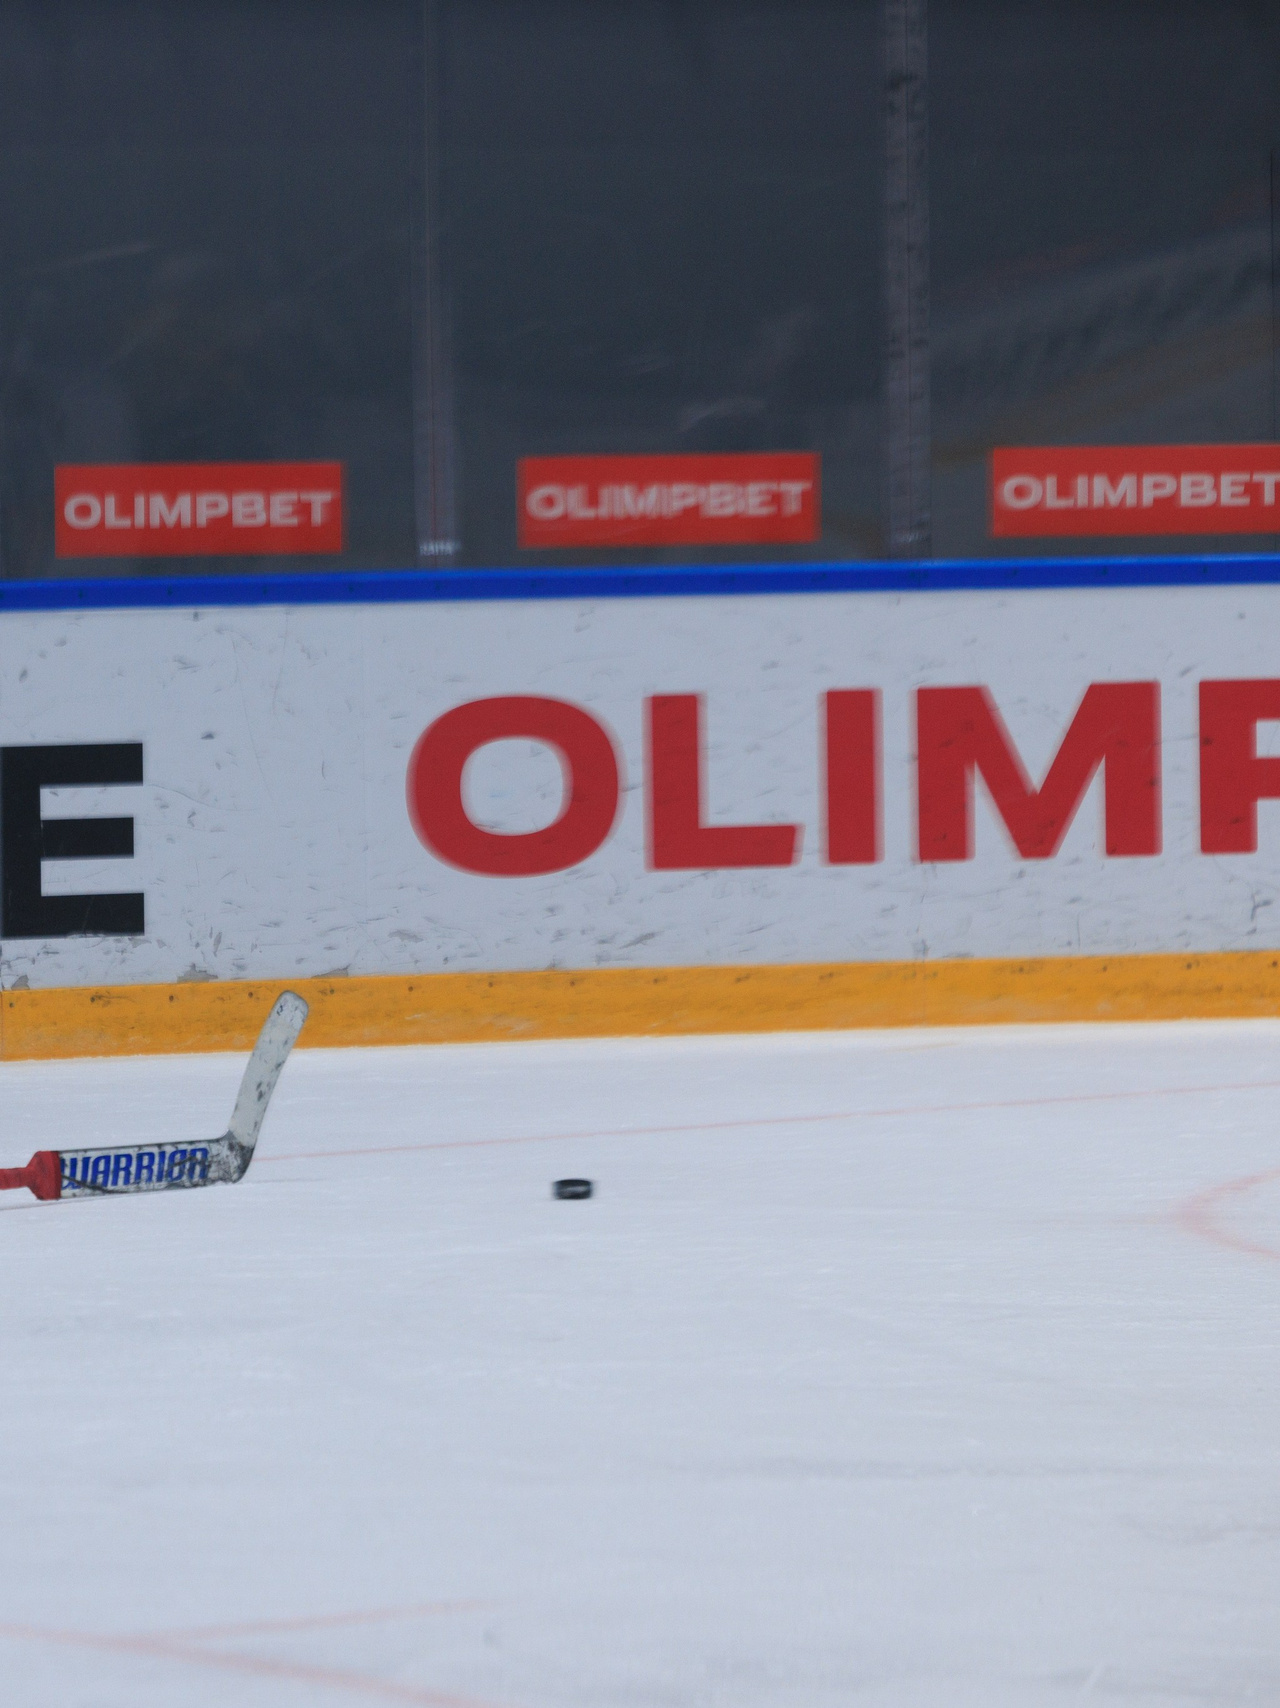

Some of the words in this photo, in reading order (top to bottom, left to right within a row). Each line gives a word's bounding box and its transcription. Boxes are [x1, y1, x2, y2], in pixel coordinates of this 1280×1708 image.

[63, 491, 333, 529] OLIMPBET
[526, 481, 812, 520] OLIMPBET
[1001, 472, 1280, 510] OLIMPBET
[60, 1147, 209, 1191] WARRIOR
